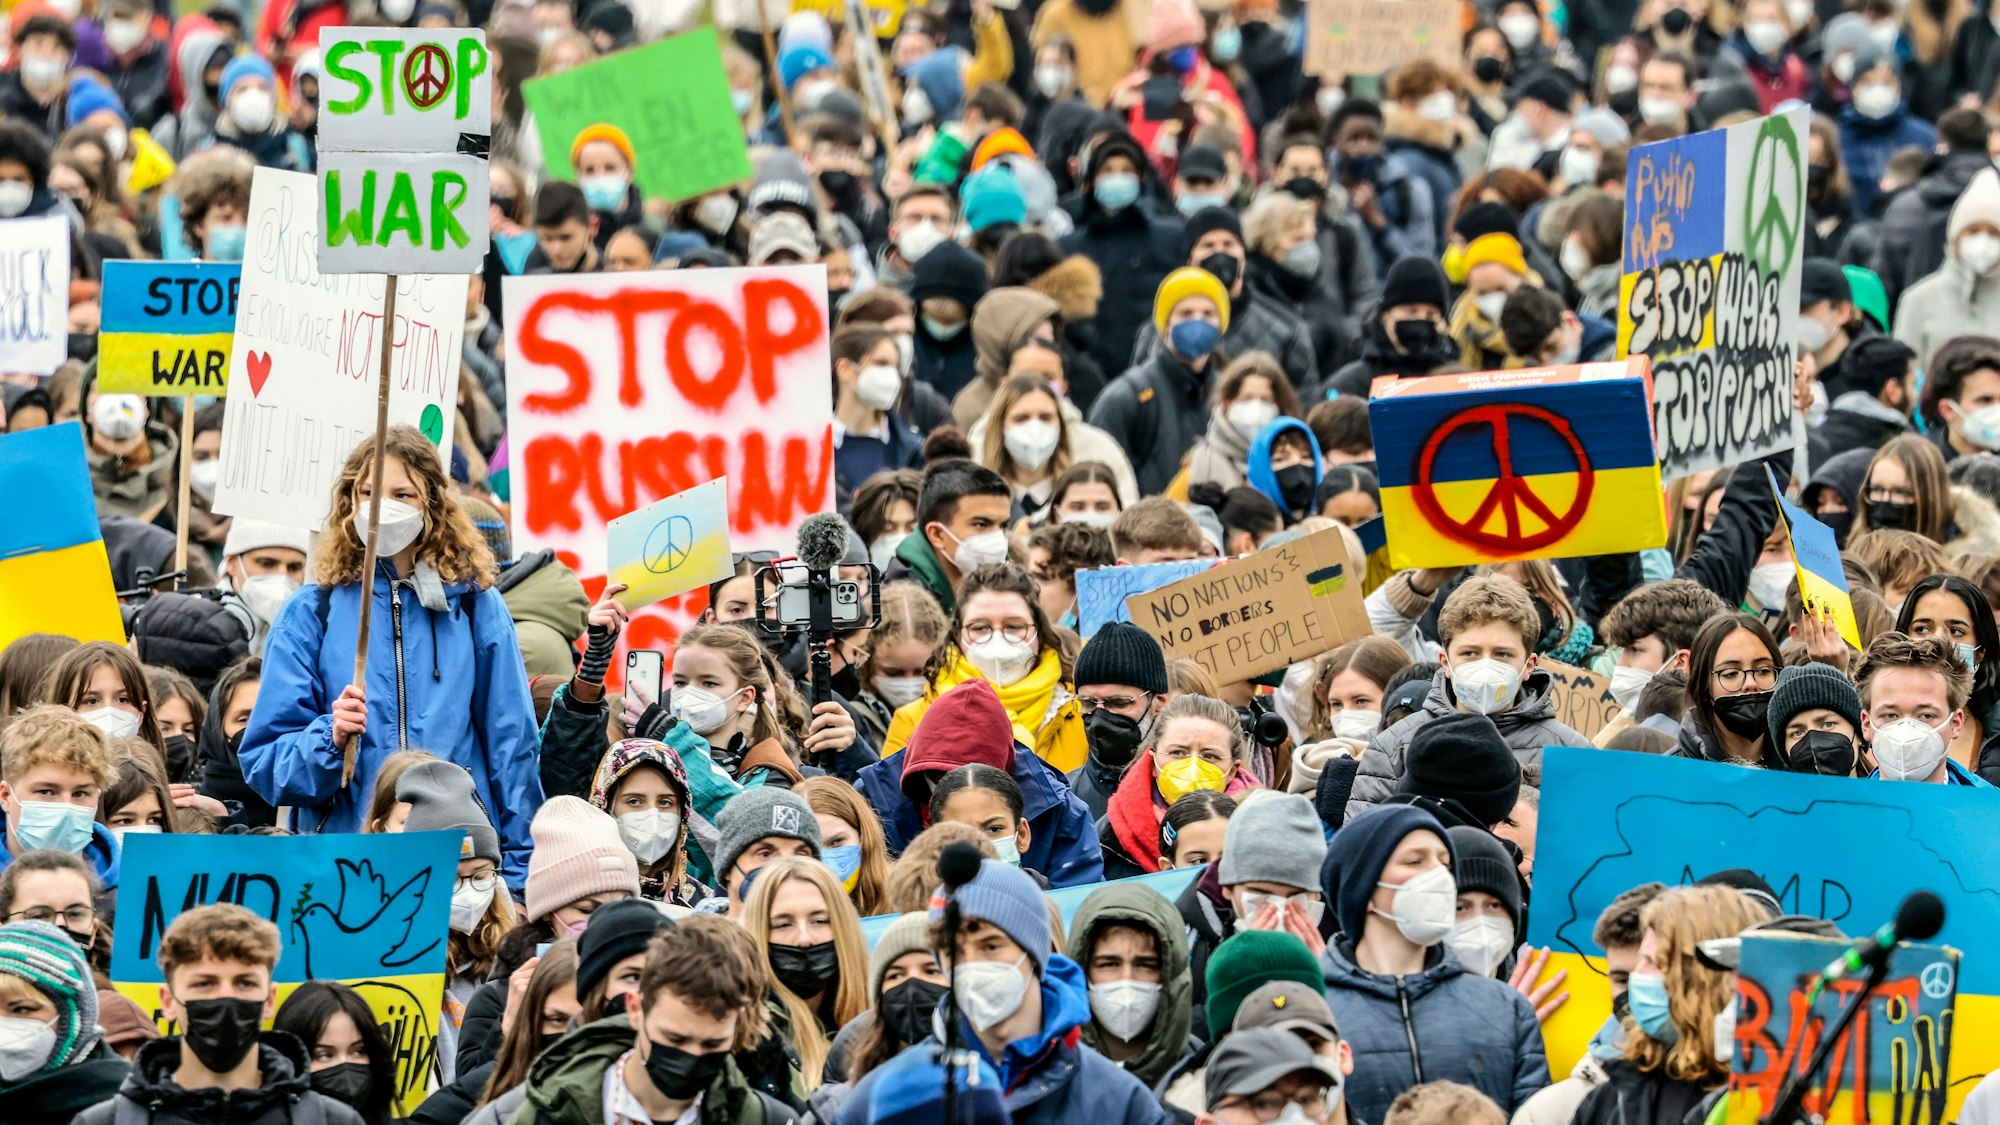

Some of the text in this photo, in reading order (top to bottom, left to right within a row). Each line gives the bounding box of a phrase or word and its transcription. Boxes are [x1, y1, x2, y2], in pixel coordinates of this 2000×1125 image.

[325, 37, 488, 120] STOP
[325, 168, 471, 251] WAR
[0, 249, 52, 296] UCK
[1629, 252, 1780, 355] STOP WAR
[152, 349, 225, 386] WAR
[336, 308, 384, 384] NOT
[391, 314, 453, 404] PUTIN
[517, 279, 822, 413] STOP
[1654, 353, 1714, 461] TOP
[523, 423, 834, 535] RUSSIAN
[1087, 570, 1135, 603] STOP
[1151, 563, 1284, 628] NO NATIONS
[1160, 600, 1275, 650] NO BORDERS
[1193, 610, 1325, 675] ST PEOPLE
